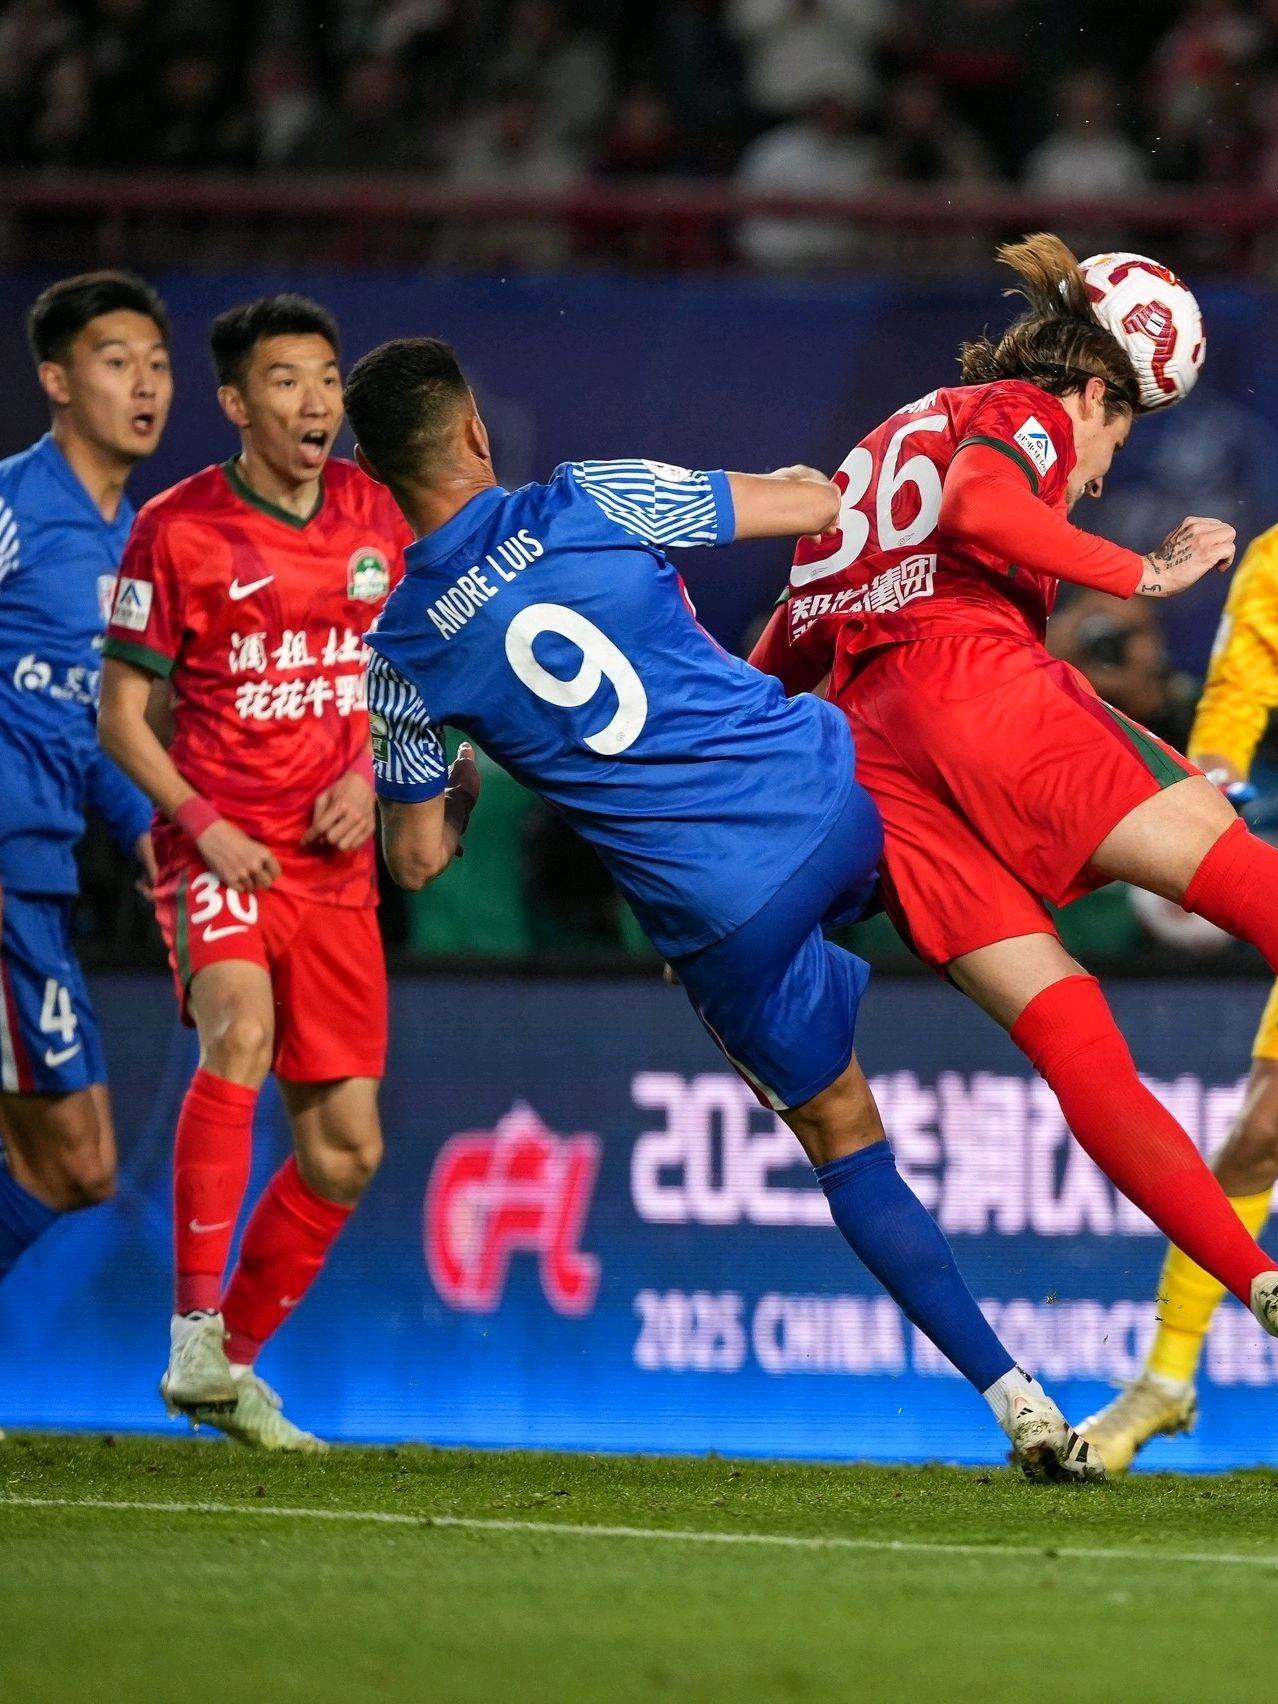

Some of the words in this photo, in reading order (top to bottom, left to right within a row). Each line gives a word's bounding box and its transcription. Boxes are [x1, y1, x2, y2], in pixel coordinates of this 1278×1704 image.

[790, 415, 948, 588] 36
[426, 565, 499, 641] ANDRE
[485, 528, 544, 583] LUIS
[229, 626, 372, 674] 酒祖杜
[505, 602, 648, 756] 9
[190, 872, 258, 925] 30
[40, 978, 78, 1043] 4
